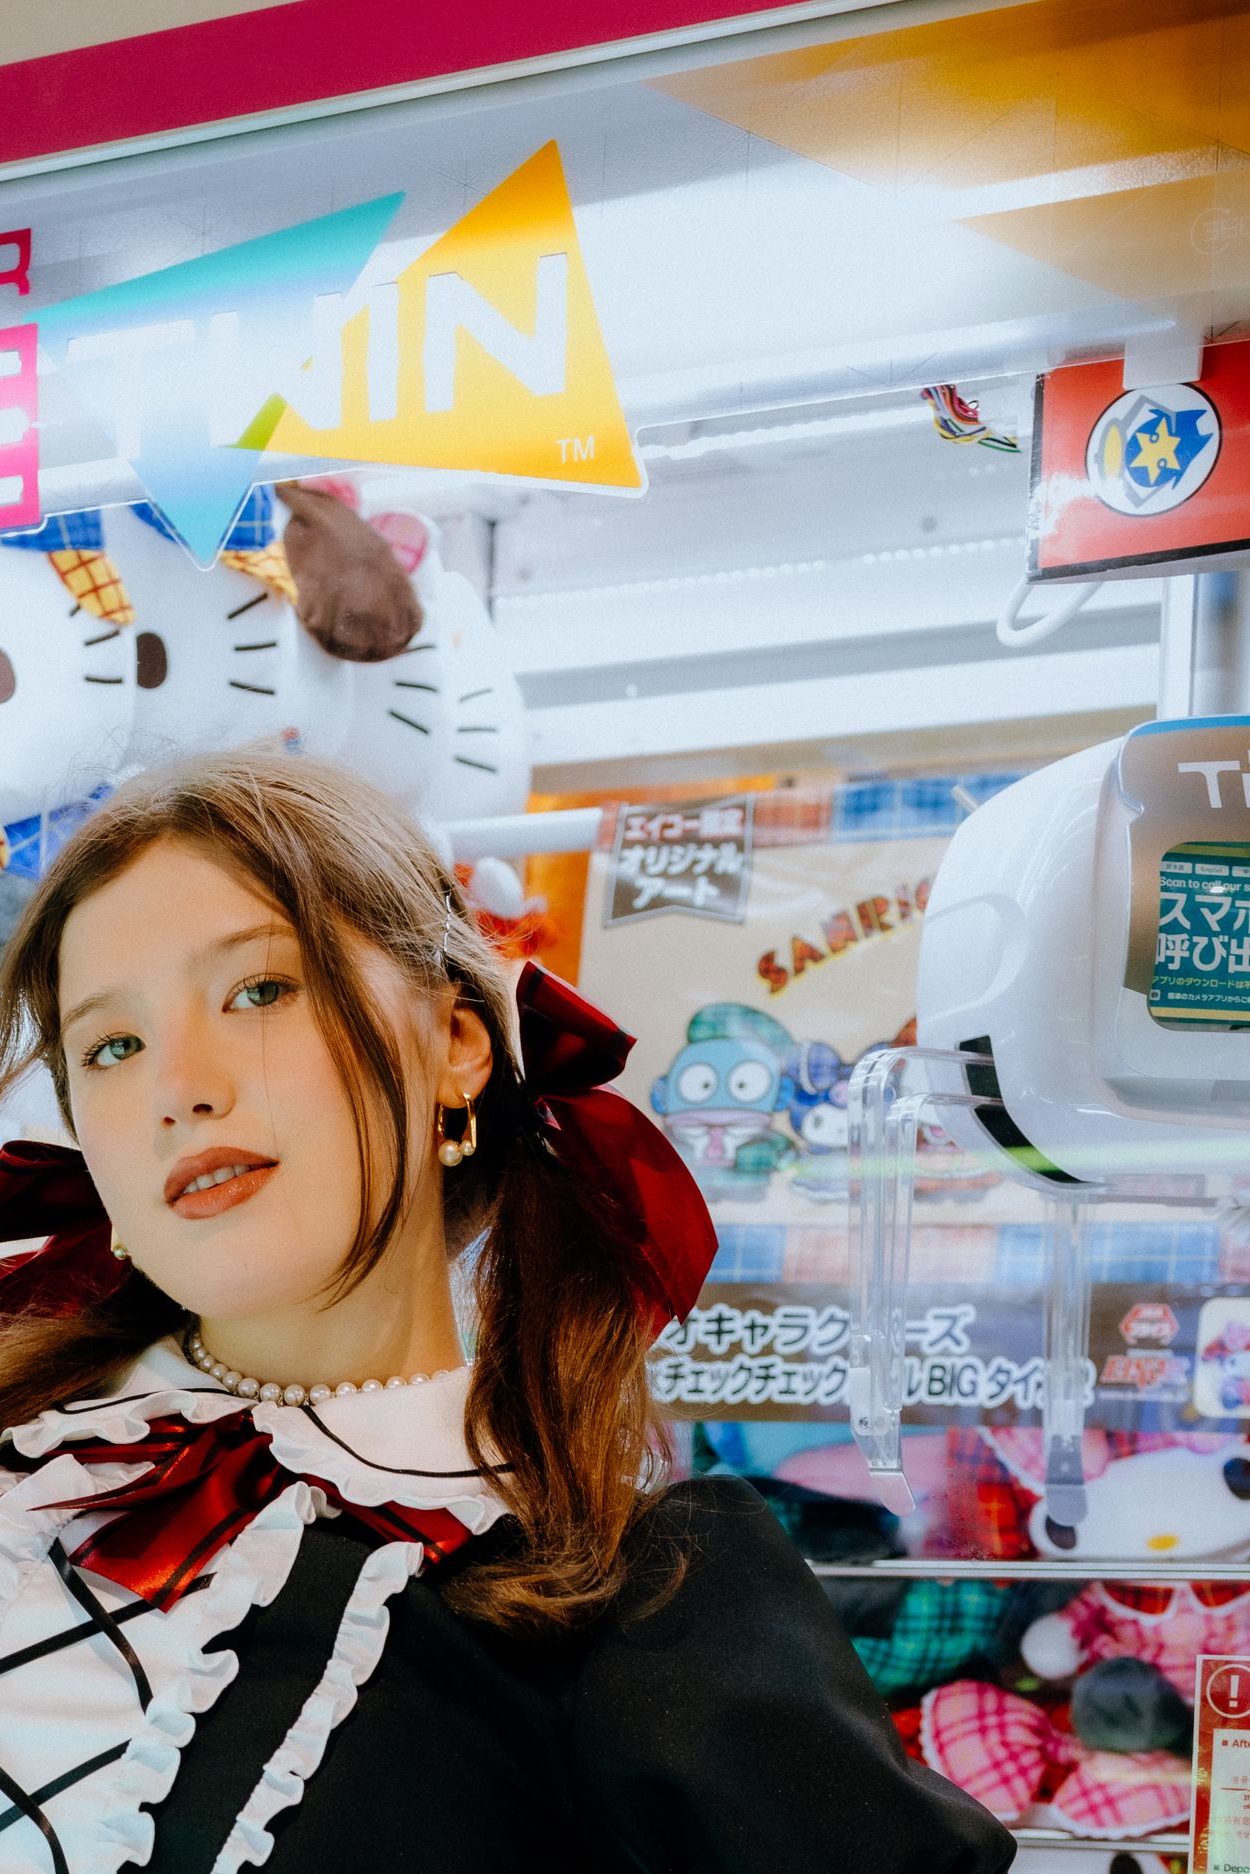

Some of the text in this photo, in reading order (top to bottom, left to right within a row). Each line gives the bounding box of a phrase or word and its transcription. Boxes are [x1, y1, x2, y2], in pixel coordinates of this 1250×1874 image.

[67, 252, 569, 461] TWIN
[1159, 876, 1186, 889] Scan
[1188, 879, 1200, 890] to
